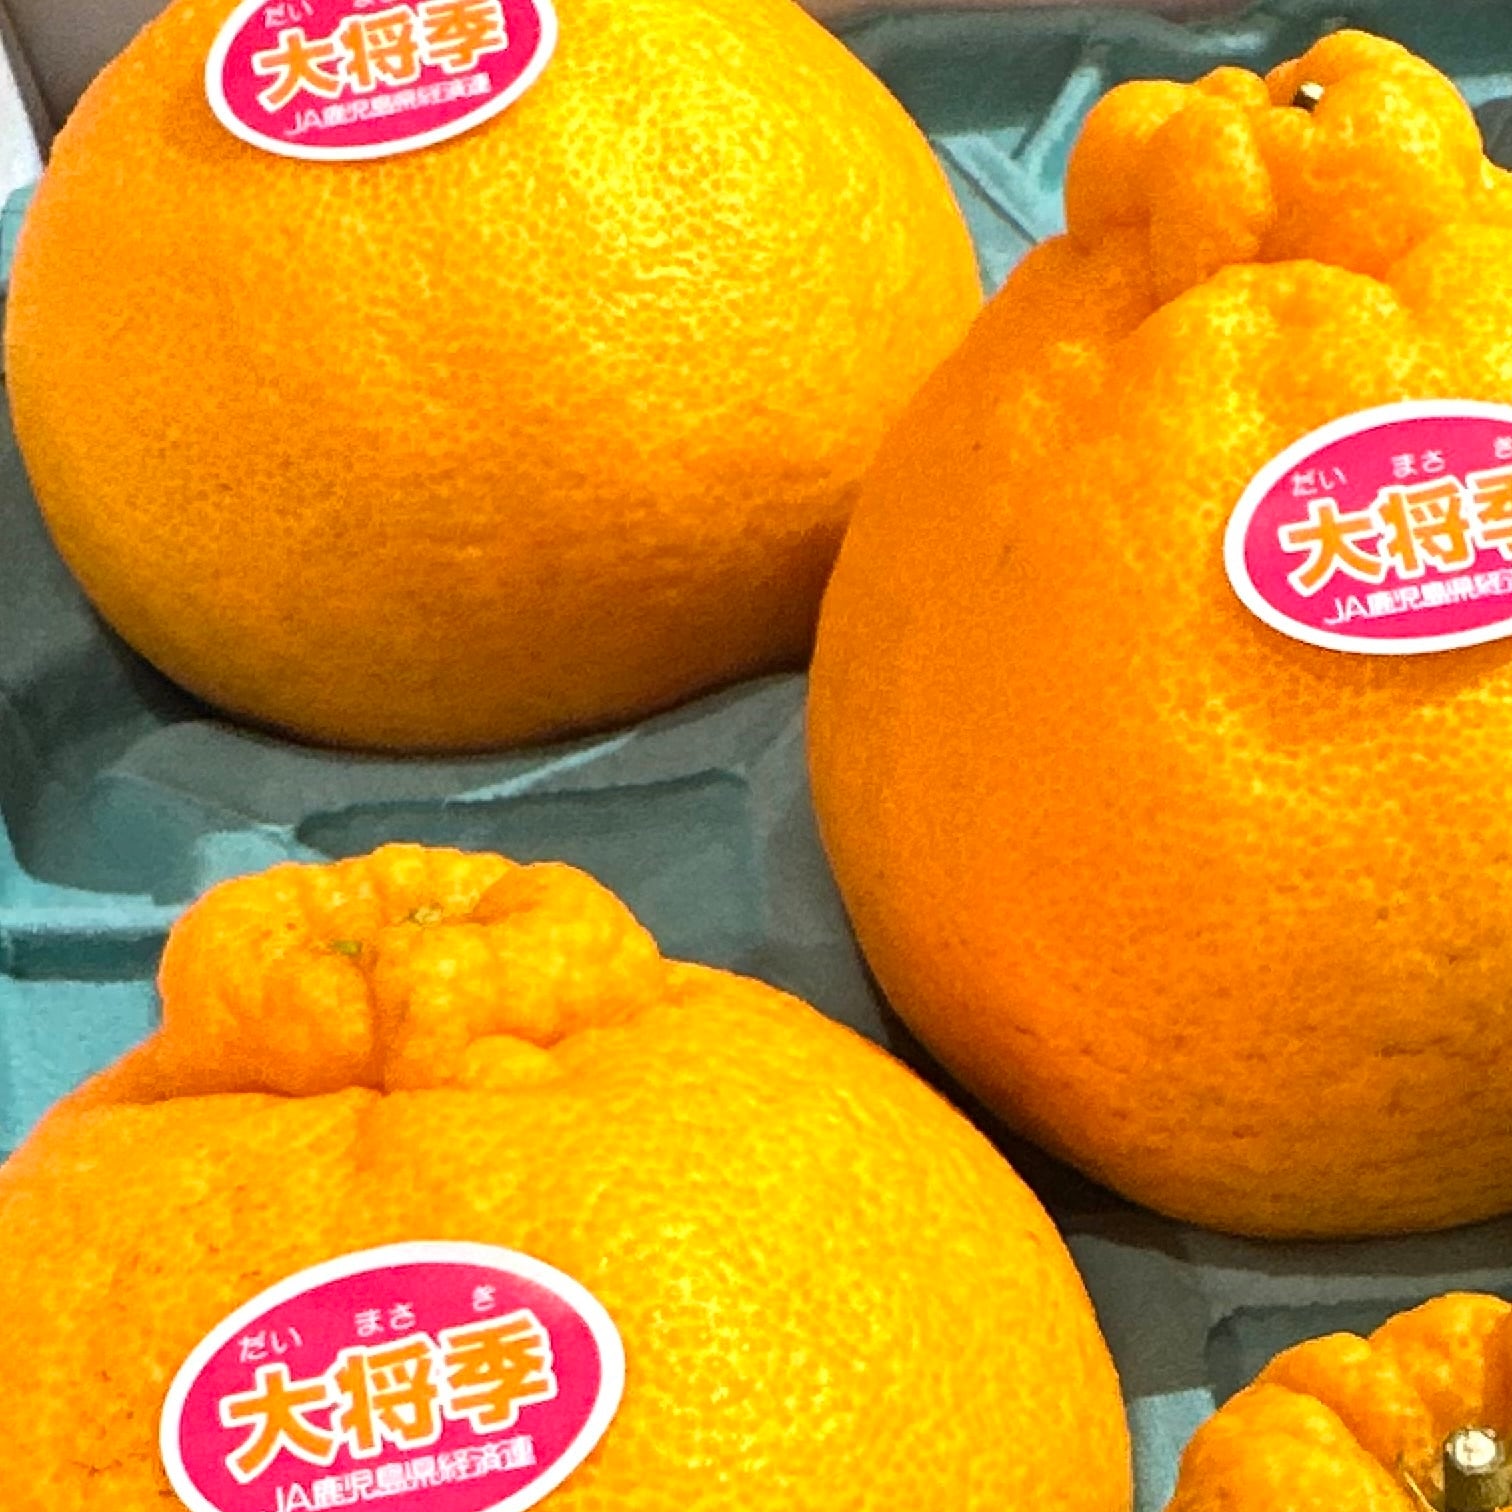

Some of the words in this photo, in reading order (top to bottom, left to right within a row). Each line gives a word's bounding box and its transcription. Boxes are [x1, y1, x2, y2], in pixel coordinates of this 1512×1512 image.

[252, 0, 508, 112] 大将季
[238, 1327, 303, 1363] だい
[355, 1301, 416, 1338] まさ
[471, 1285, 497, 1312] き
[219, 1308, 558, 1485] 大将季
